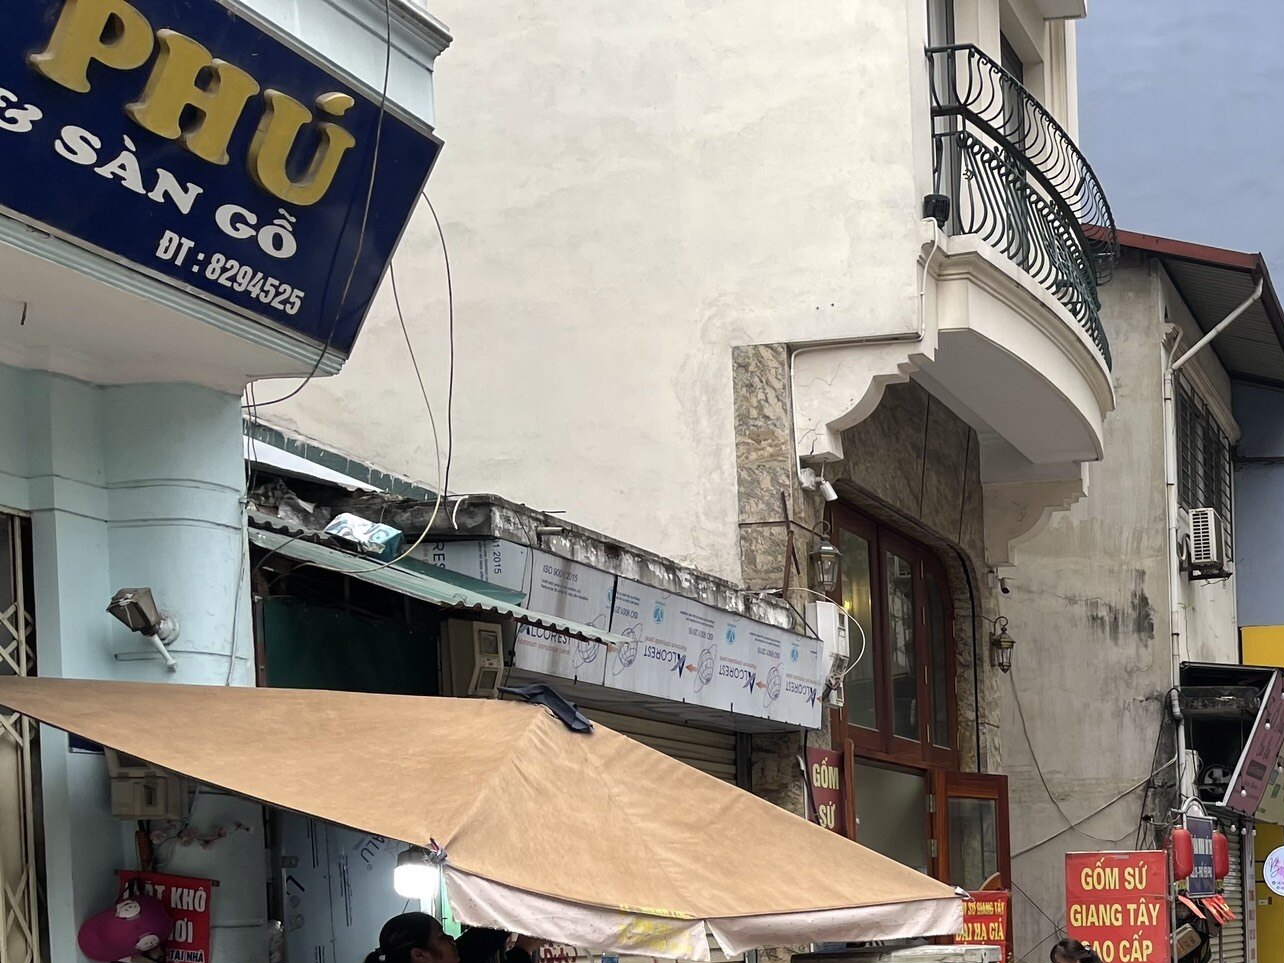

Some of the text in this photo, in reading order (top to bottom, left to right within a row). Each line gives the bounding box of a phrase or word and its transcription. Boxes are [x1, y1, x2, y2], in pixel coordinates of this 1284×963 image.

[29, 0, 356, 206] PHÚ
[54, 125, 204, 215] SÀN
[215, 204, 298, 260] GỖ
[204, 252, 305, 317] 8294525
[812, 756, 839, 791] GỐM
[818, 803, 838, 829] SỨ
[1080, 857, 1148, 891] GỐM SỨ
[170, 886, 207, 912] KHÔ
[1070, 897, 1160, 927] GIANG TÂY
[167, 917, 194, 943] ƠI
[1119, 930, 1153, 963] CẤP
